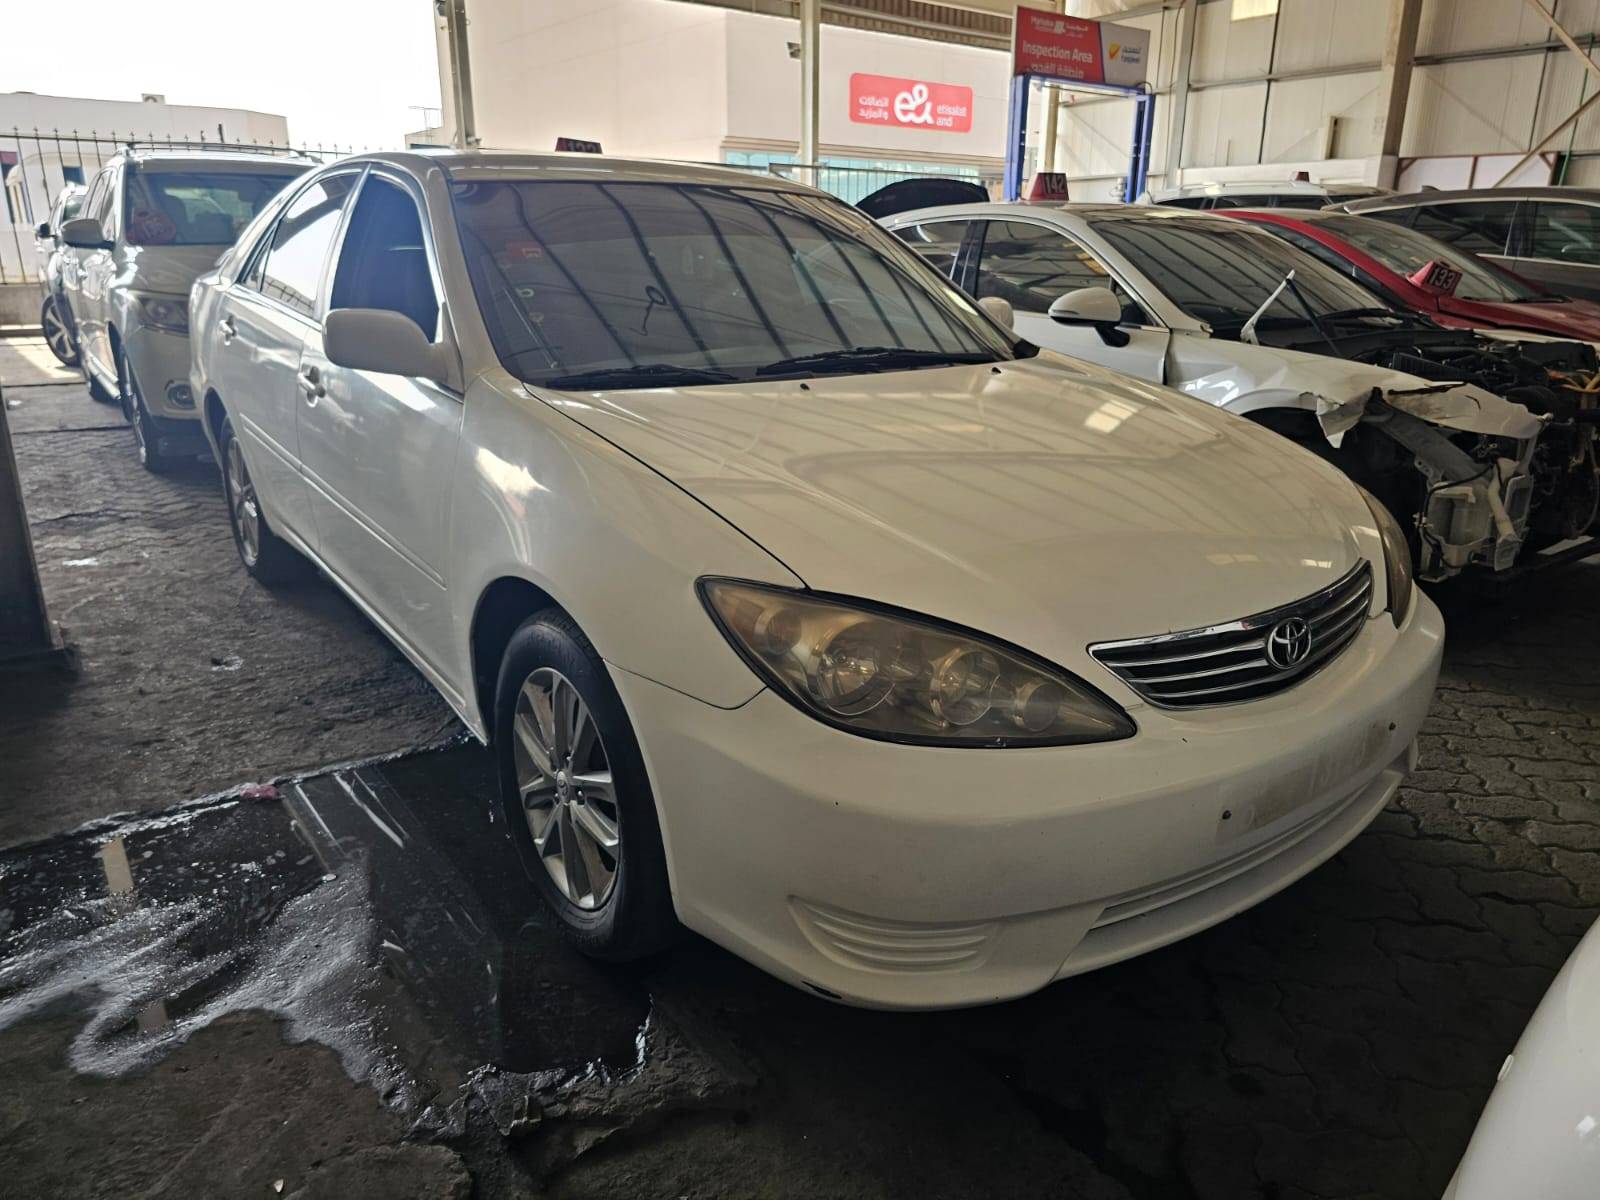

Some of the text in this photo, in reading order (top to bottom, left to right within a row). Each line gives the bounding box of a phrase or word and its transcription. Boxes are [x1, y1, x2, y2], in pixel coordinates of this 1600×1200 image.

[1022, 40, 1093, 64] Inspection Area
[1045, 174, 1065, 194] 142
[1429, 265, 1456, 289] 133
